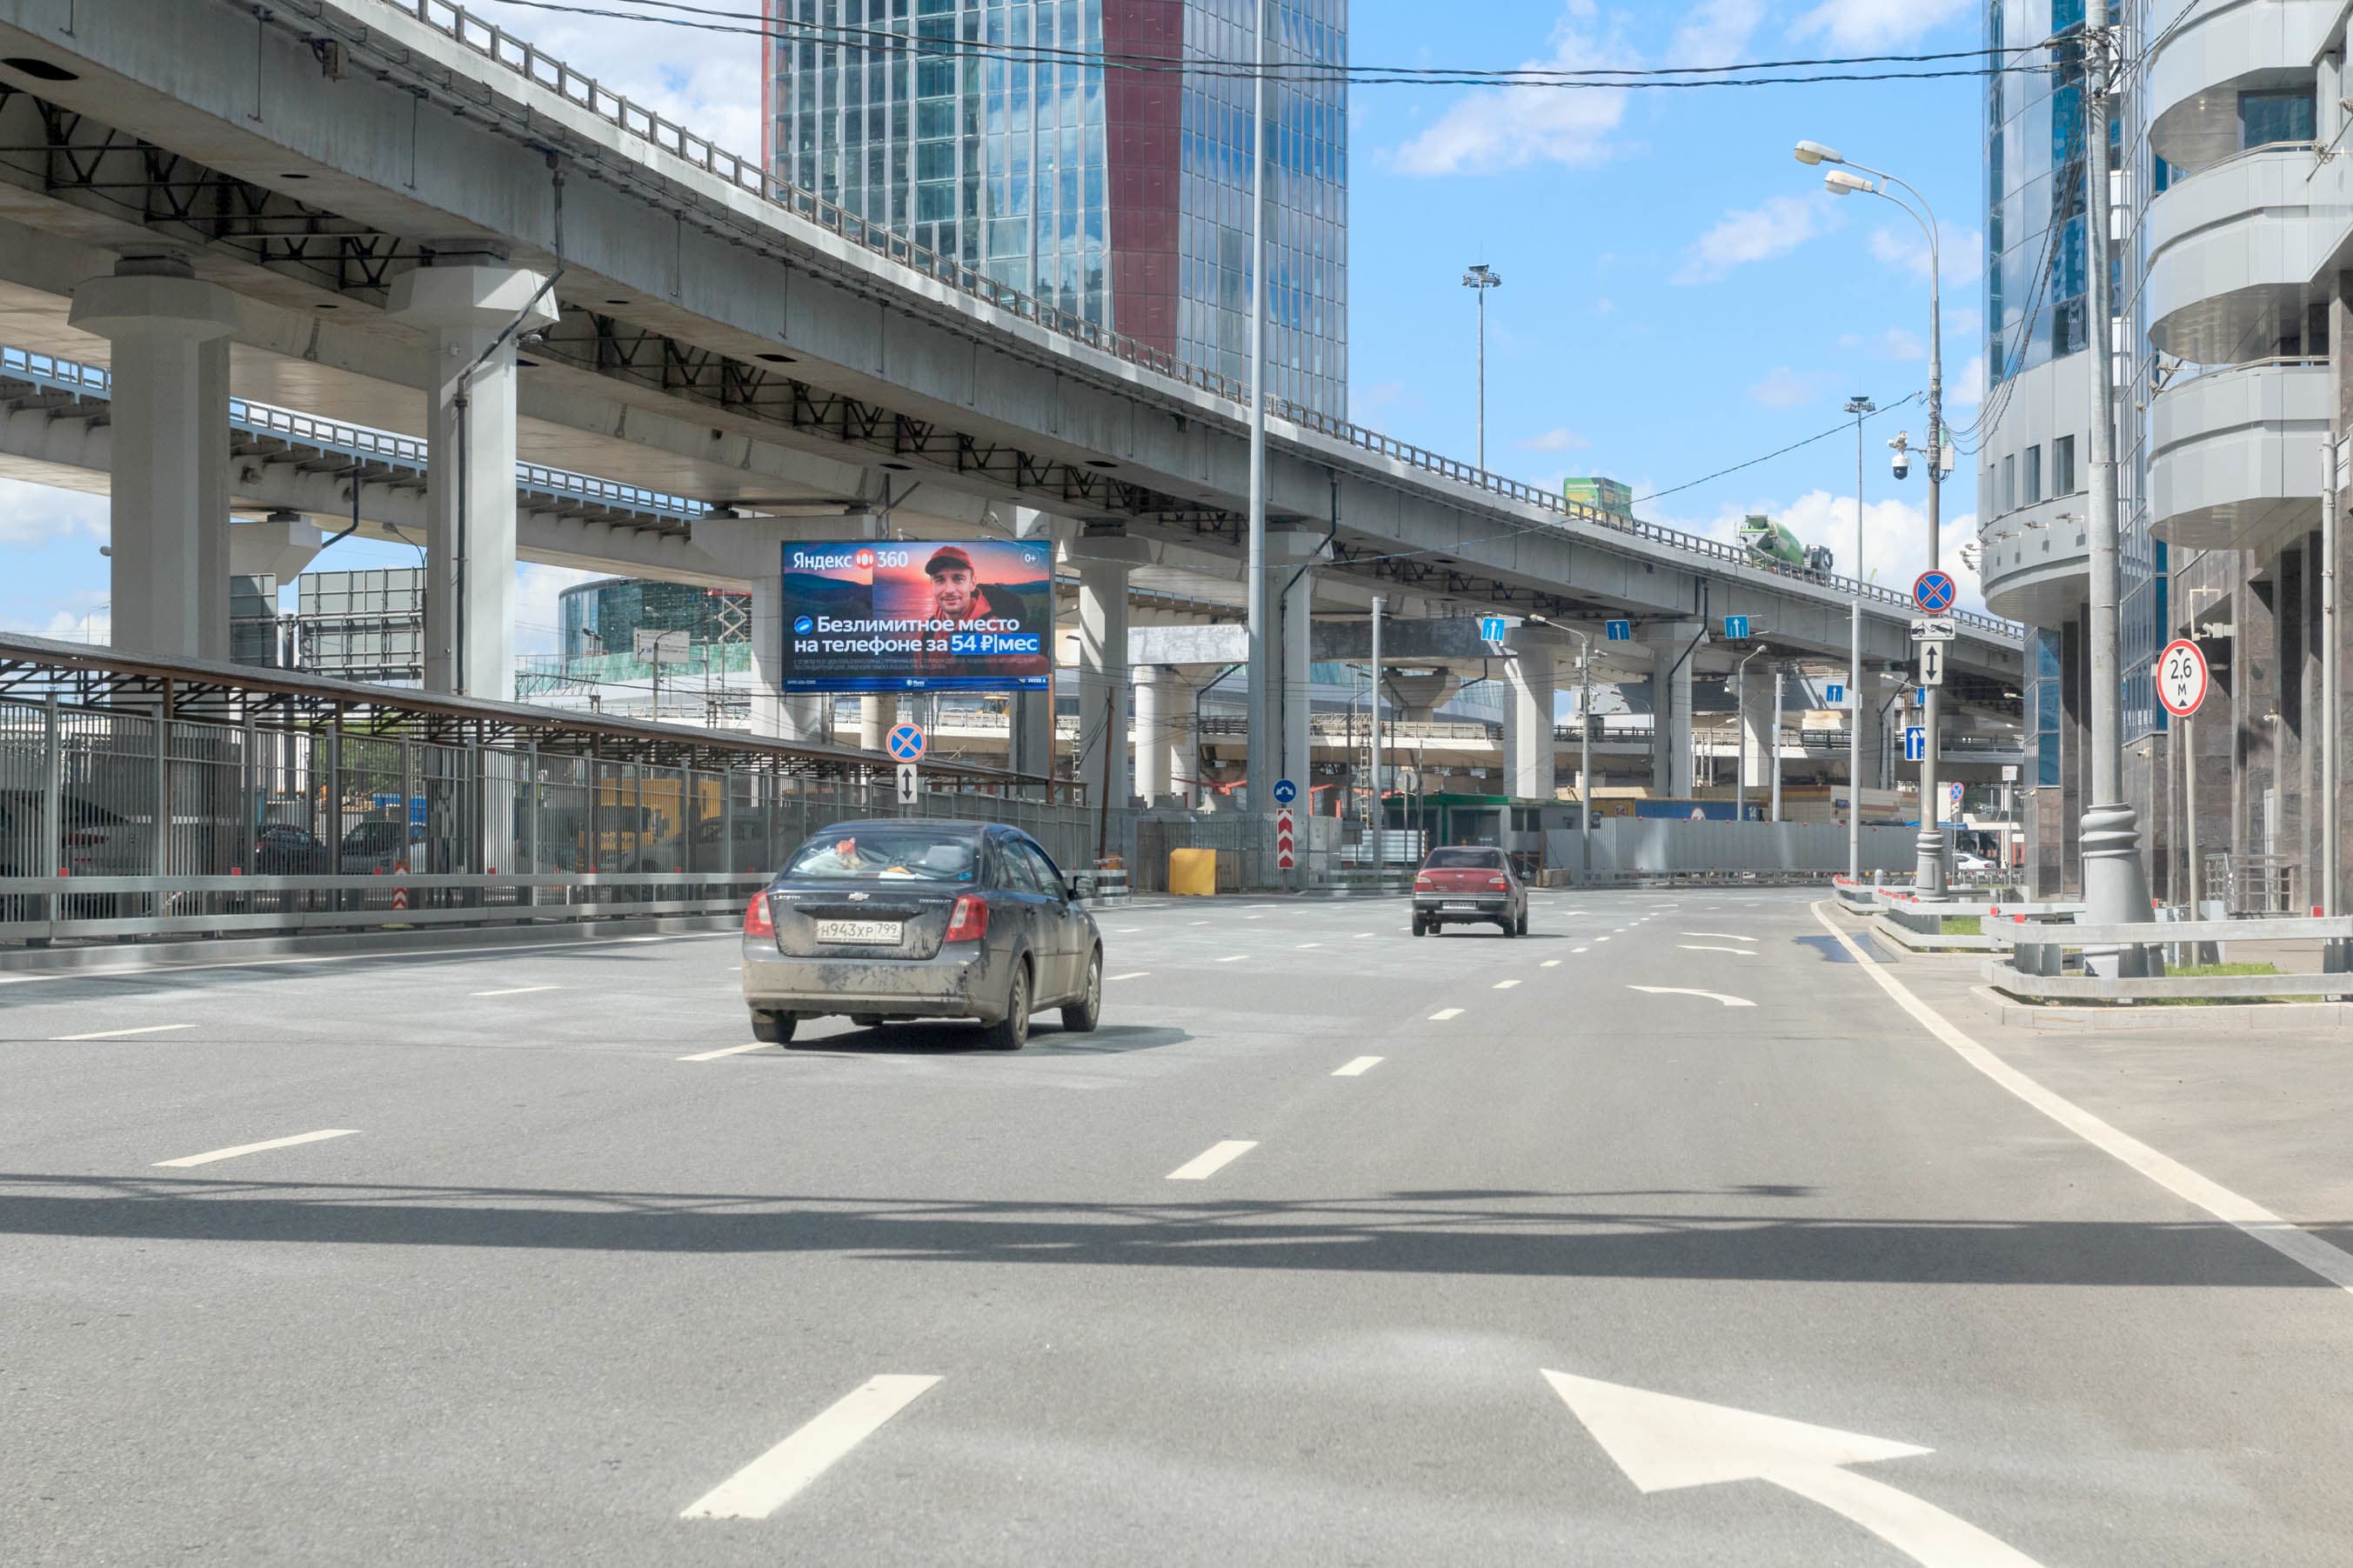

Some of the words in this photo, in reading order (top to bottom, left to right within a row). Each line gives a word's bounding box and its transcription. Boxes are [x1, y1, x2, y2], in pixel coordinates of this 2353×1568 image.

[793, 551, 852, 570] Яндекс
[877, 550, 909, 568] 360
[1025, 553, 1036, 563] 0+
[817, 616, 955, 633] Безлимитное
[958, 618, 1020, 631] место
[793, 639, 819, 653] на
[821, 636, 923, 656] телефоне
[926, 639, 948, 652] за
[952, 634, 977, 651] 54
[876, 923, 898, 934] 799
